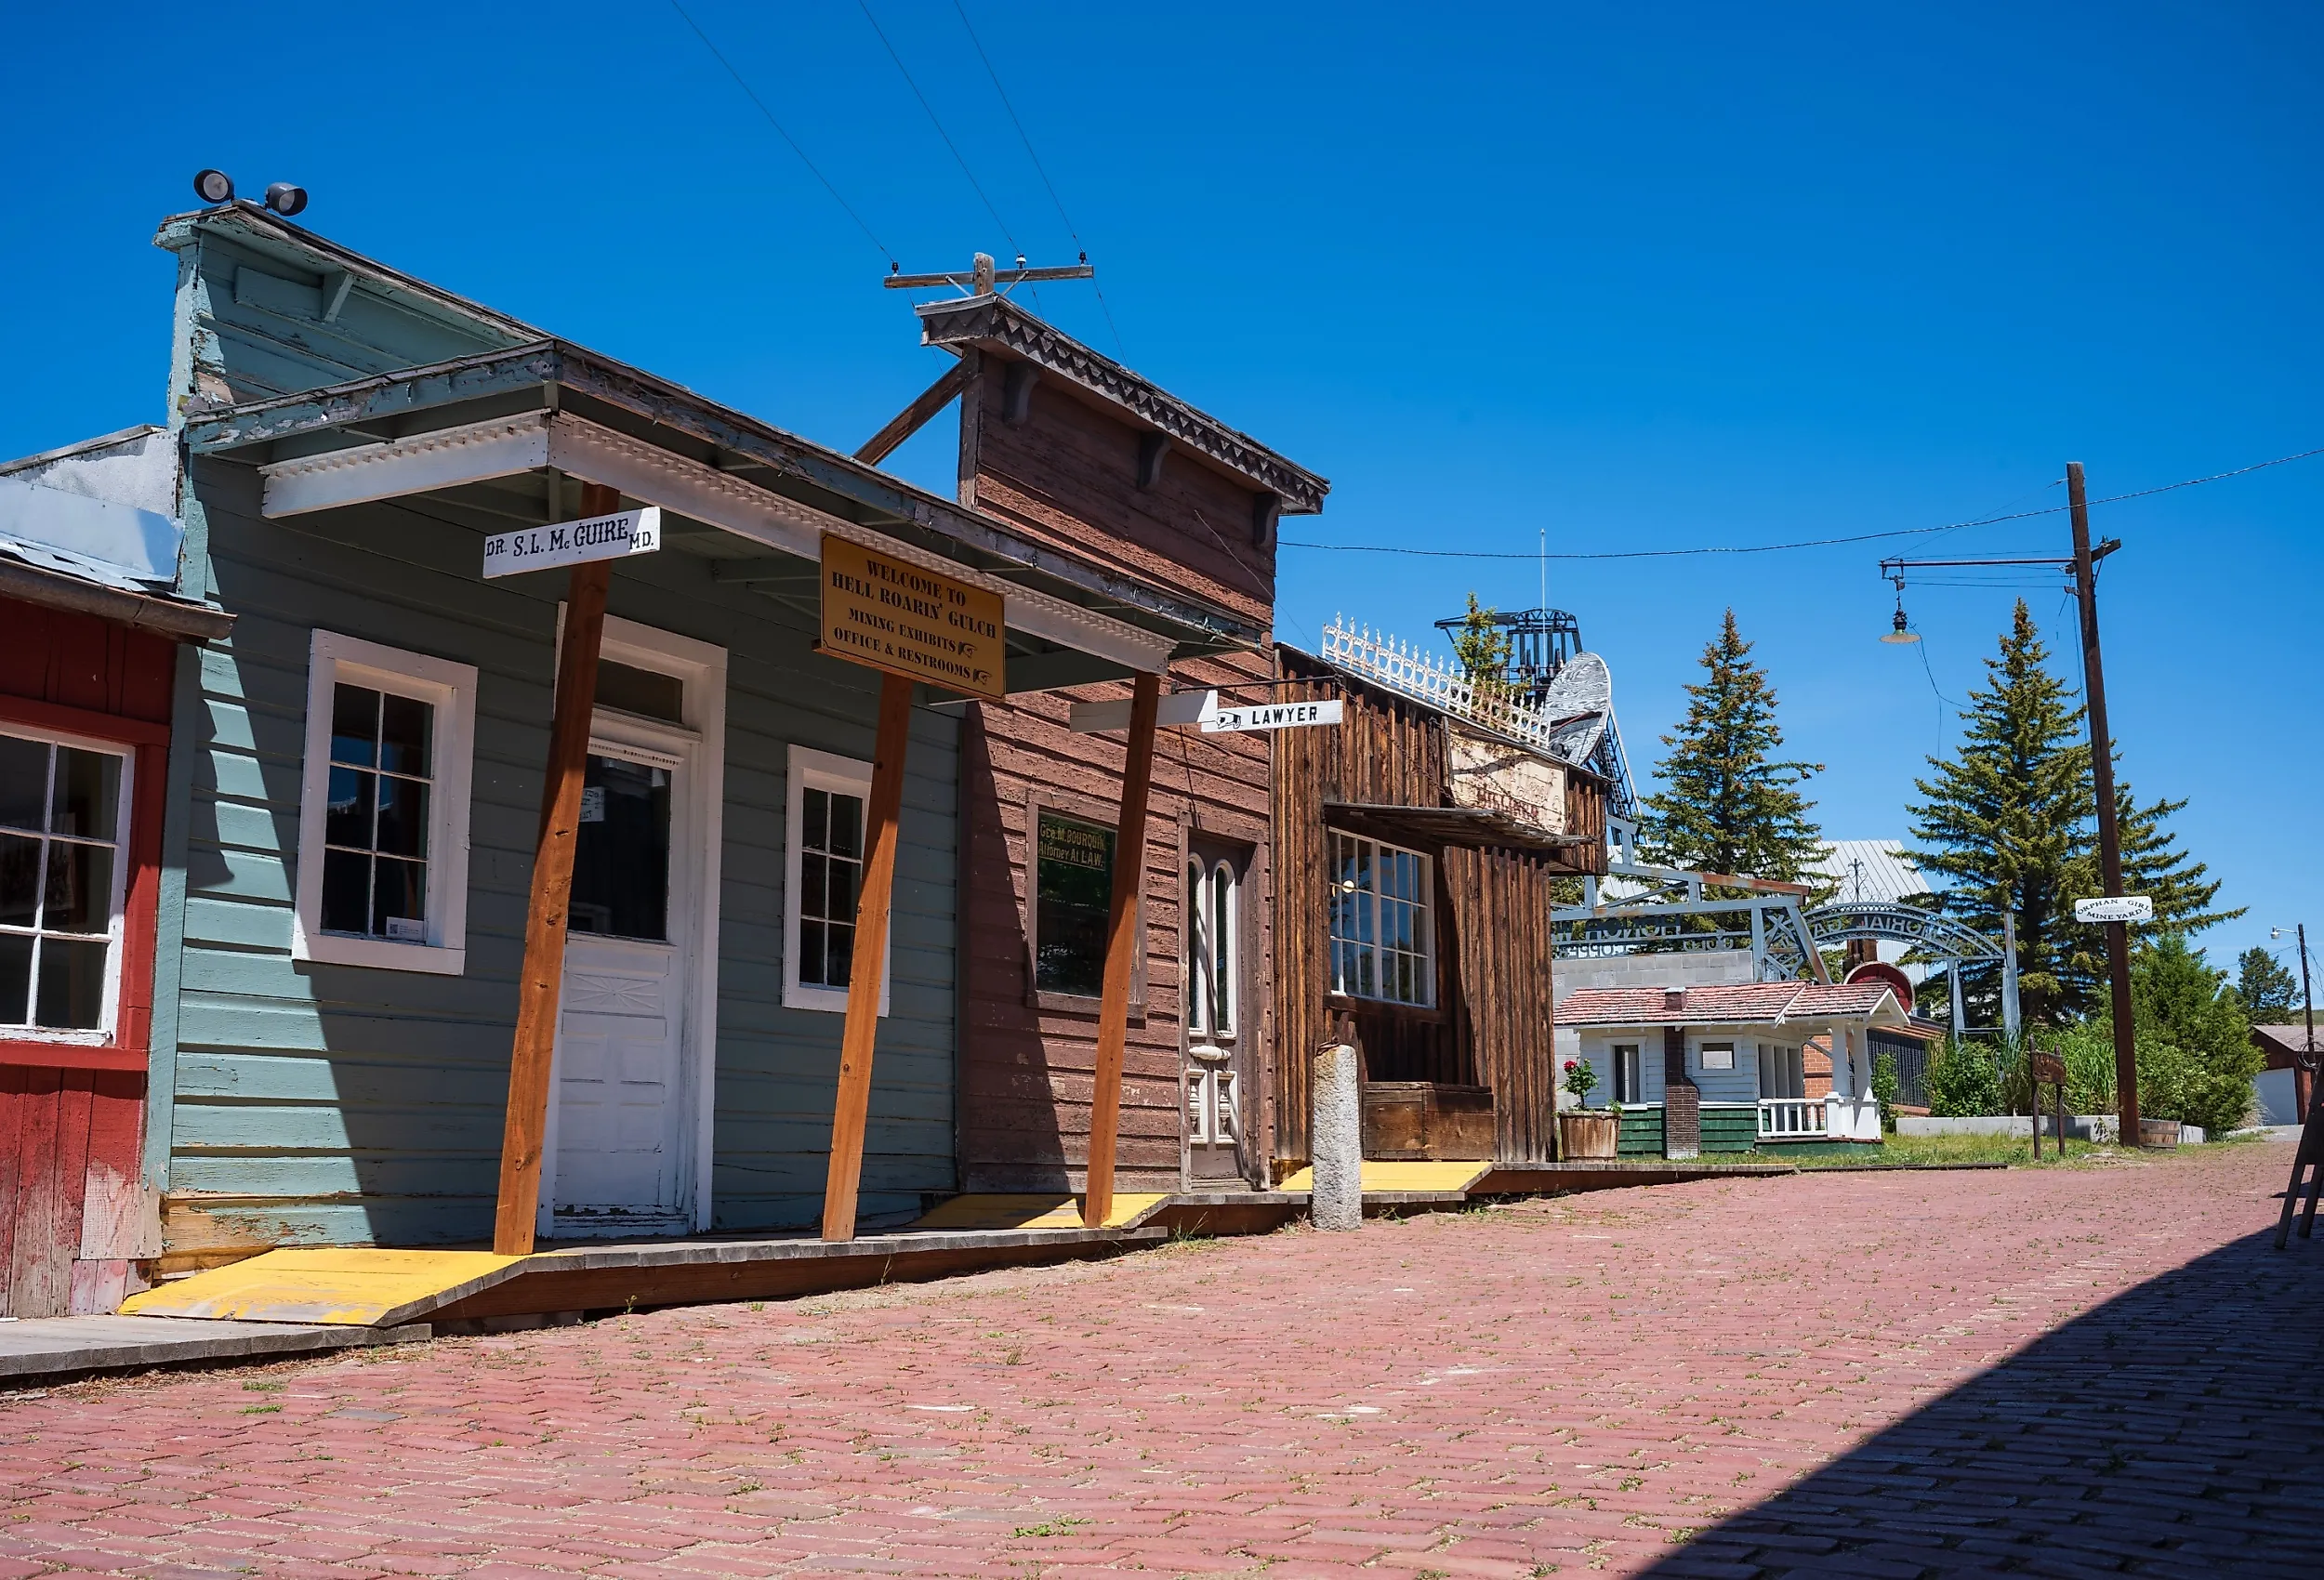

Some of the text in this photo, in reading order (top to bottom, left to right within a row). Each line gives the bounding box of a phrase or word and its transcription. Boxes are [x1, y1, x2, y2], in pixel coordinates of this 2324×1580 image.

[486, 539, 508, 558] DR.
[513, 533, 545, 557] S.L.
[866, 560, 966, 607] WELCOME TO
[832, 572, 997, 639] HELL ROARIN' GULCH
[849, 608, 956, 652] MINING EXHIBITS
[834, 627, 971, 679] OFFICE & RESTROOMS
[1252, 706, 1318, 725] LAWYER
[2077, 899, 2151, 915] ORPHAN GIRL
[2086, 912, 2114, 920] MINE
[2116, 909, 2143, 920] YARD
